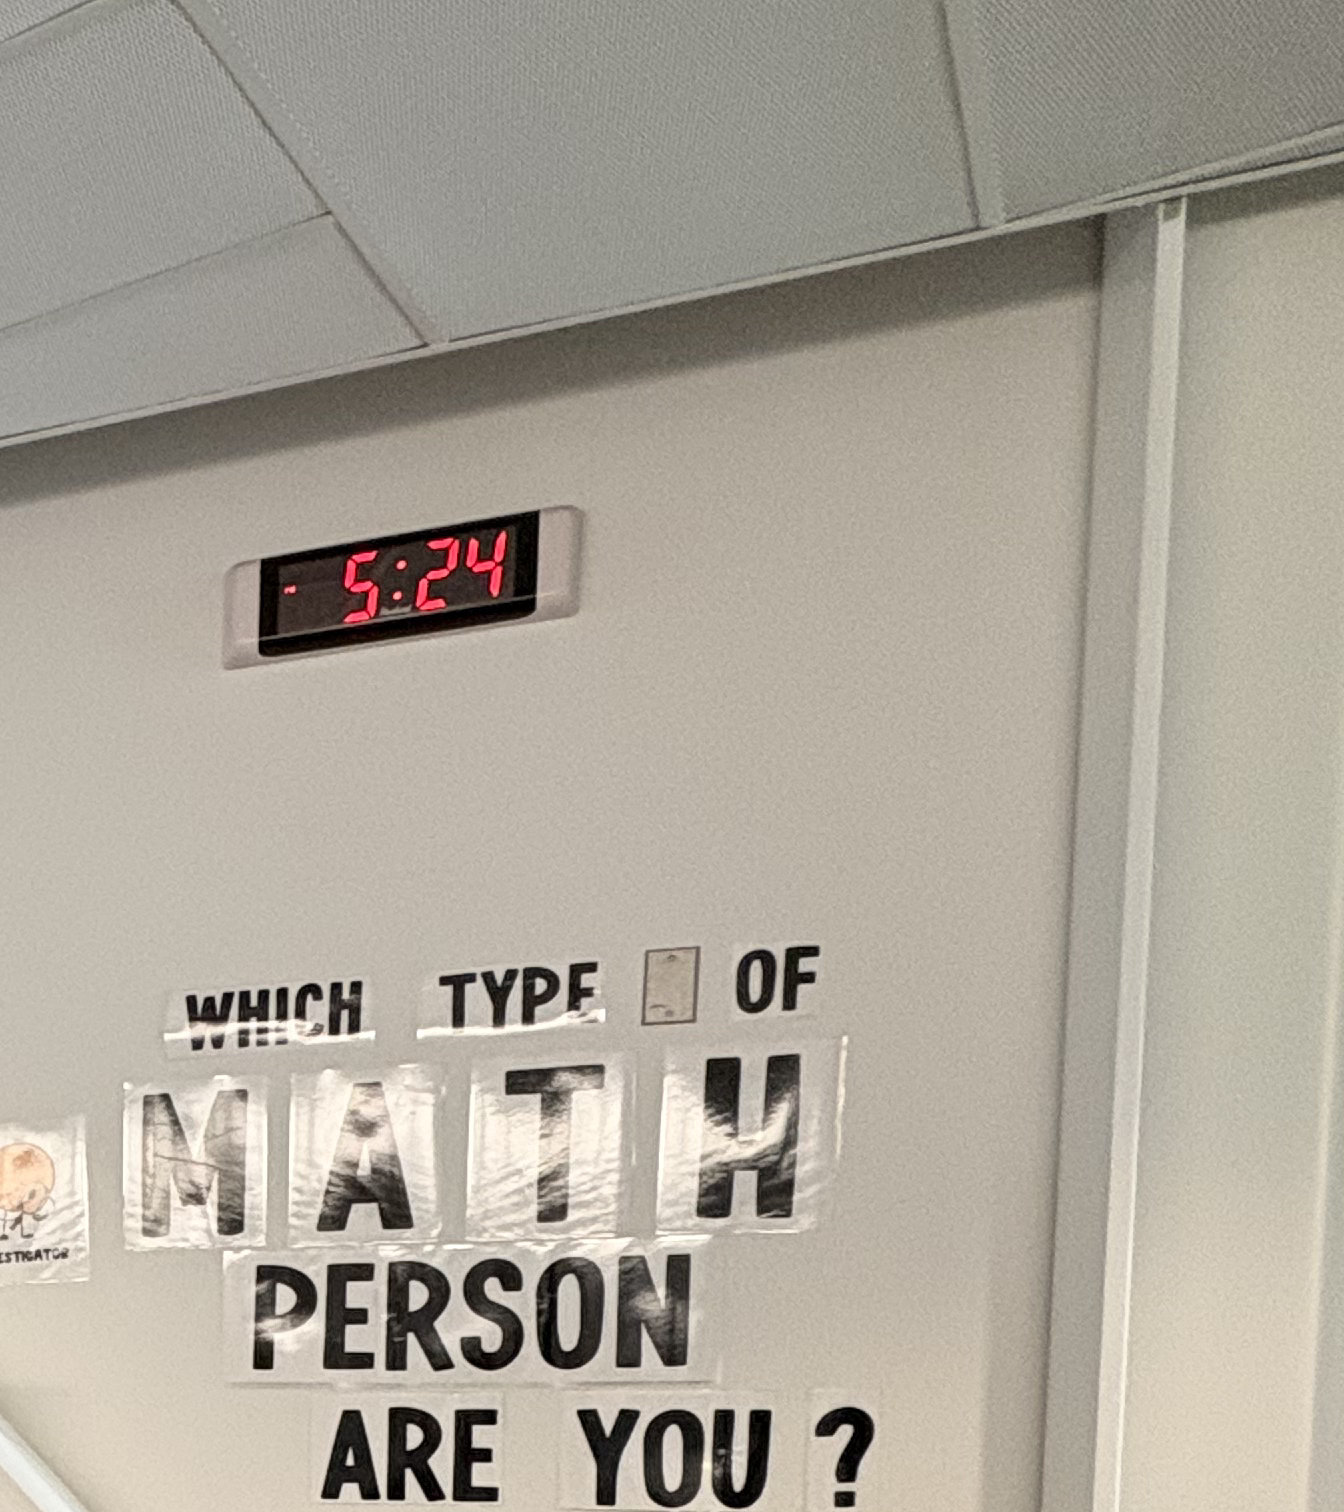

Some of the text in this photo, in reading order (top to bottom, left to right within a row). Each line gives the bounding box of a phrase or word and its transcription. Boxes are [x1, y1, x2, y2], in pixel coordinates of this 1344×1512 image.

[344, 531, 507, 624] 5:24
[186, 945, 821, 1051] WHICH TYPE OF
[141, 1053, 801, 1238] MATH
[252, 1253, 692, 1372] PERSON
[320, 1406, 875, 1509] ARE YOU ?
